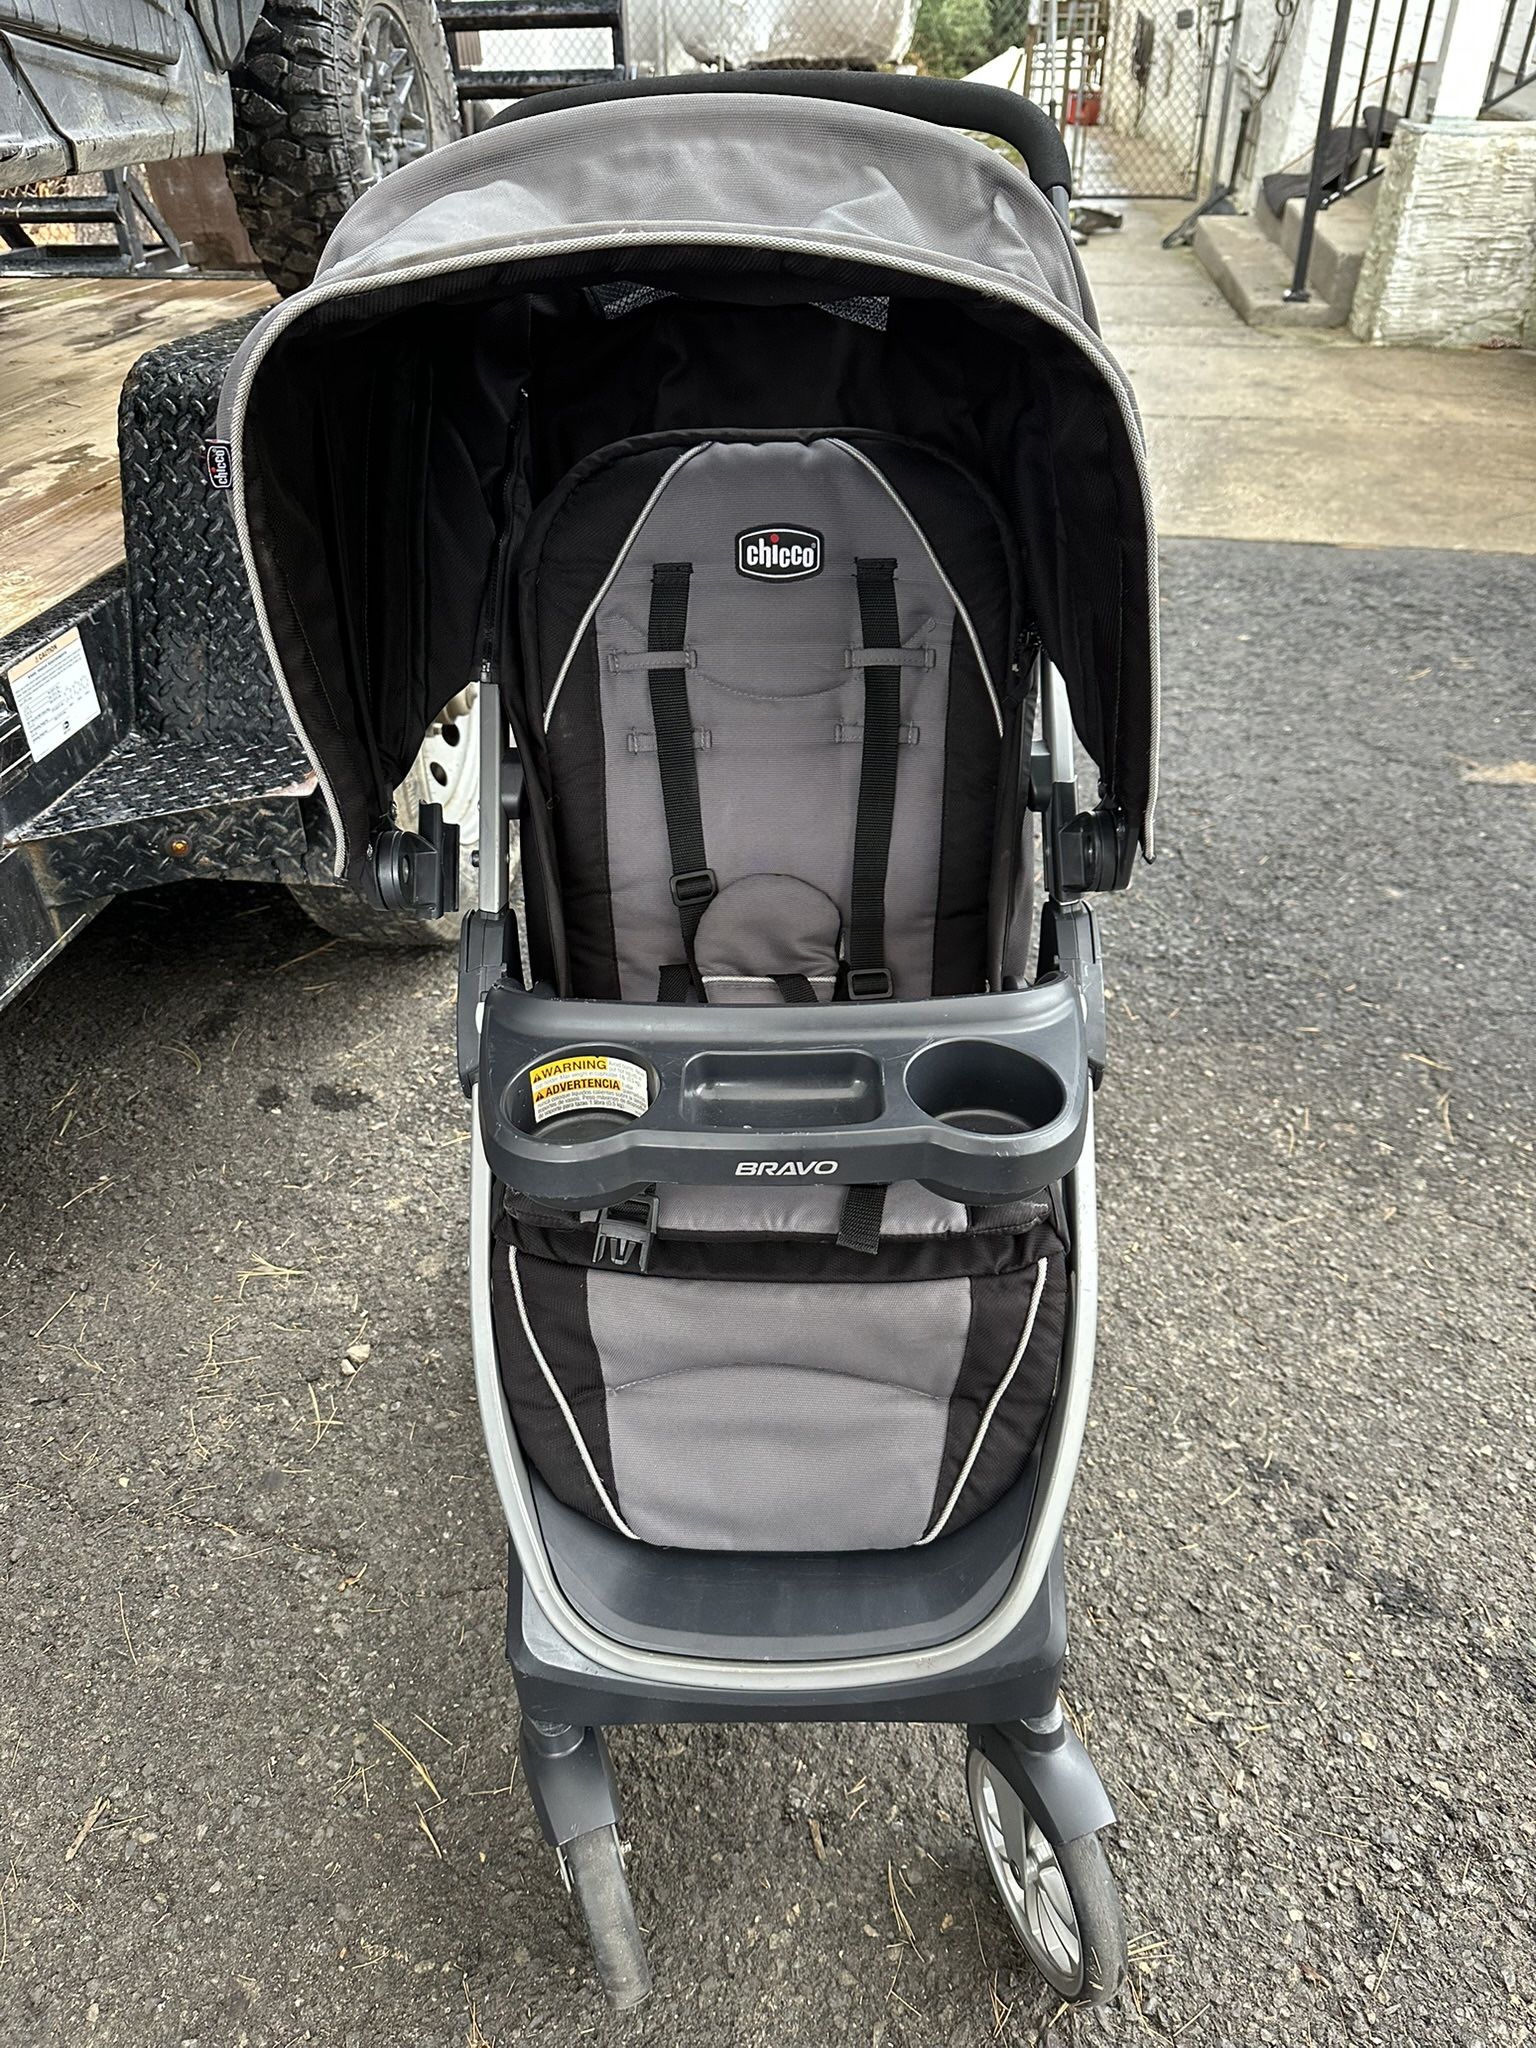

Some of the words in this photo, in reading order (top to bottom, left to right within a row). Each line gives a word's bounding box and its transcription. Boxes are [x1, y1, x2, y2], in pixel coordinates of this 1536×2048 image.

[211, 450, 228, 484] chicco
[746, 533, 814, 568] chicco
[38, 644, 58, 661] CAUTION
[541, 1060, 607, 1079] WARNING
[545, 1078, 620, 1098] ADVERTENCIA
[735, 1161, 838, 1176] BRAVO
